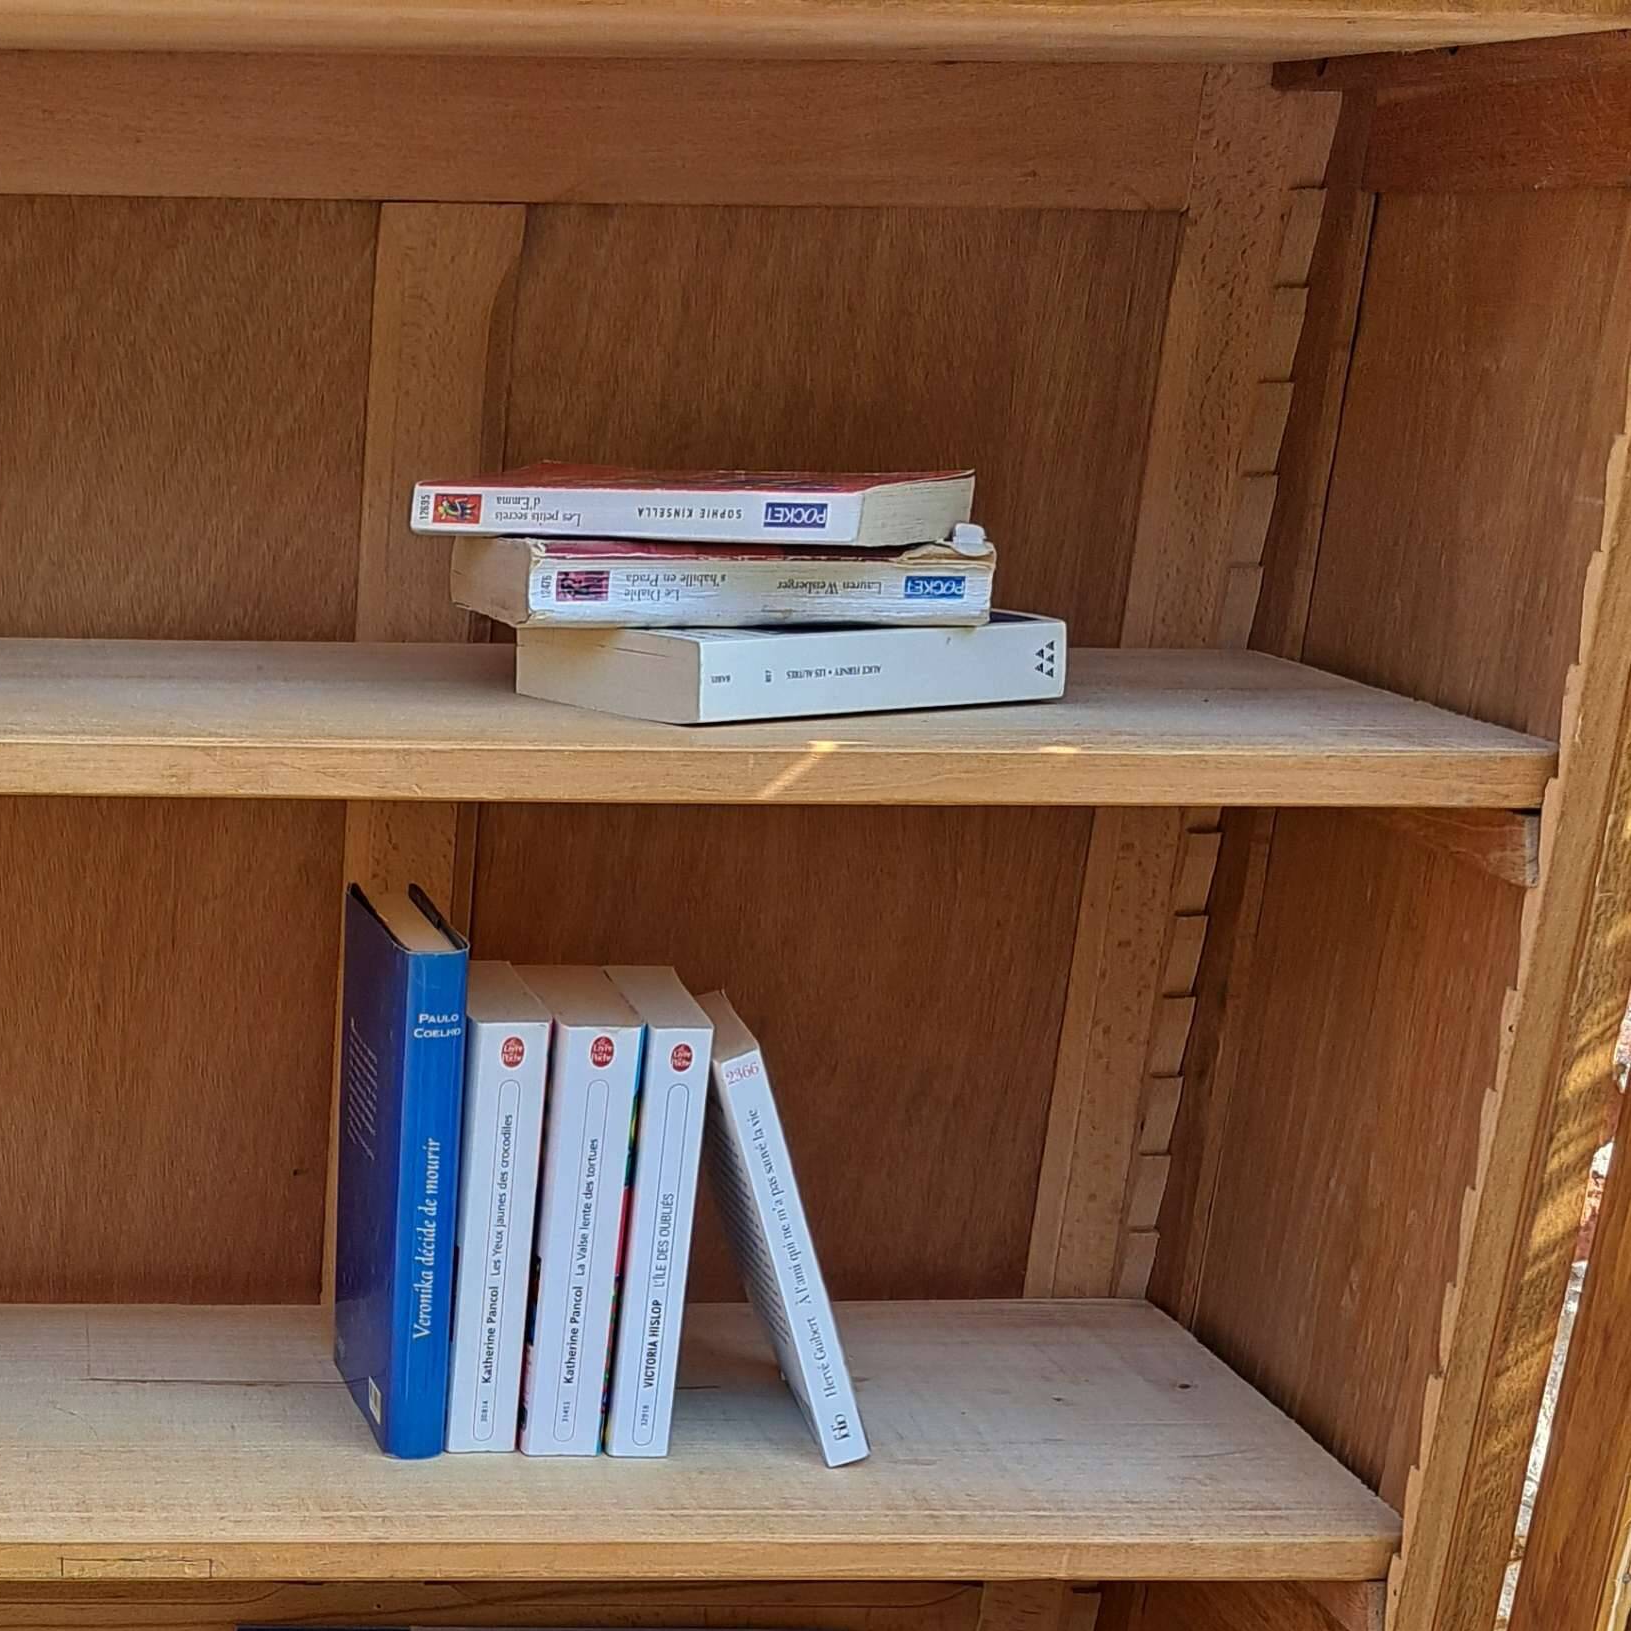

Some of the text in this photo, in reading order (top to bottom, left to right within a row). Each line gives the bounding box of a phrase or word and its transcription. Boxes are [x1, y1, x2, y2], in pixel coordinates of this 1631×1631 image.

[495, 496, 541, 511] d'Emma
[636, 506, 742, 520] SOPHIE KINSELLA
[494, 510, 581, 527] Les petits secrets
[763, 505, 827, 525] POCKET
[625, 573, 727, 588] s'habille en Prada
[777, 578, 882, 595] Lauren Weisberger
[903, 578, 965, 596] POCKET
[624, 588, 680, 601] Le Diable
[786, 665, 881, 680] ALICE FERNEY LES AUTRES
[418, 1013, 459, 1024] PAULO
[413, 1027, 462, 1040] COELHO
[725, 1062, 760, 1085] 2366
[747, 1109, 762, 1127] vie
[752, 1128, 765, 1141] la
[755, 1142, 774, 1174] sauvé
[768, 1175, 785, 1197] pas
[772, 1201, 789, 1222] m'a
[412, 1137, 441, 1341] Veronika décide de mourir
[781, 1222, 793, 1241] ne
[481, 1114, 513, 1384] Katherine Pancol Les Yeux jaunes des crocodiles
[785, 1242, 802, 1263] qui
[563, 1138, 599, 1384] Katherine Pancol La Valse lente des tortues
[643, 1192, 675, 1388] VICTORIA HISLOP L'ÎLE DES OUBLIÉS
[787, 1264, 810, 1297] l'ami
[807, 1316, 829, 1361] Guibert
[818, 1363, 838, 1398] Hervé
